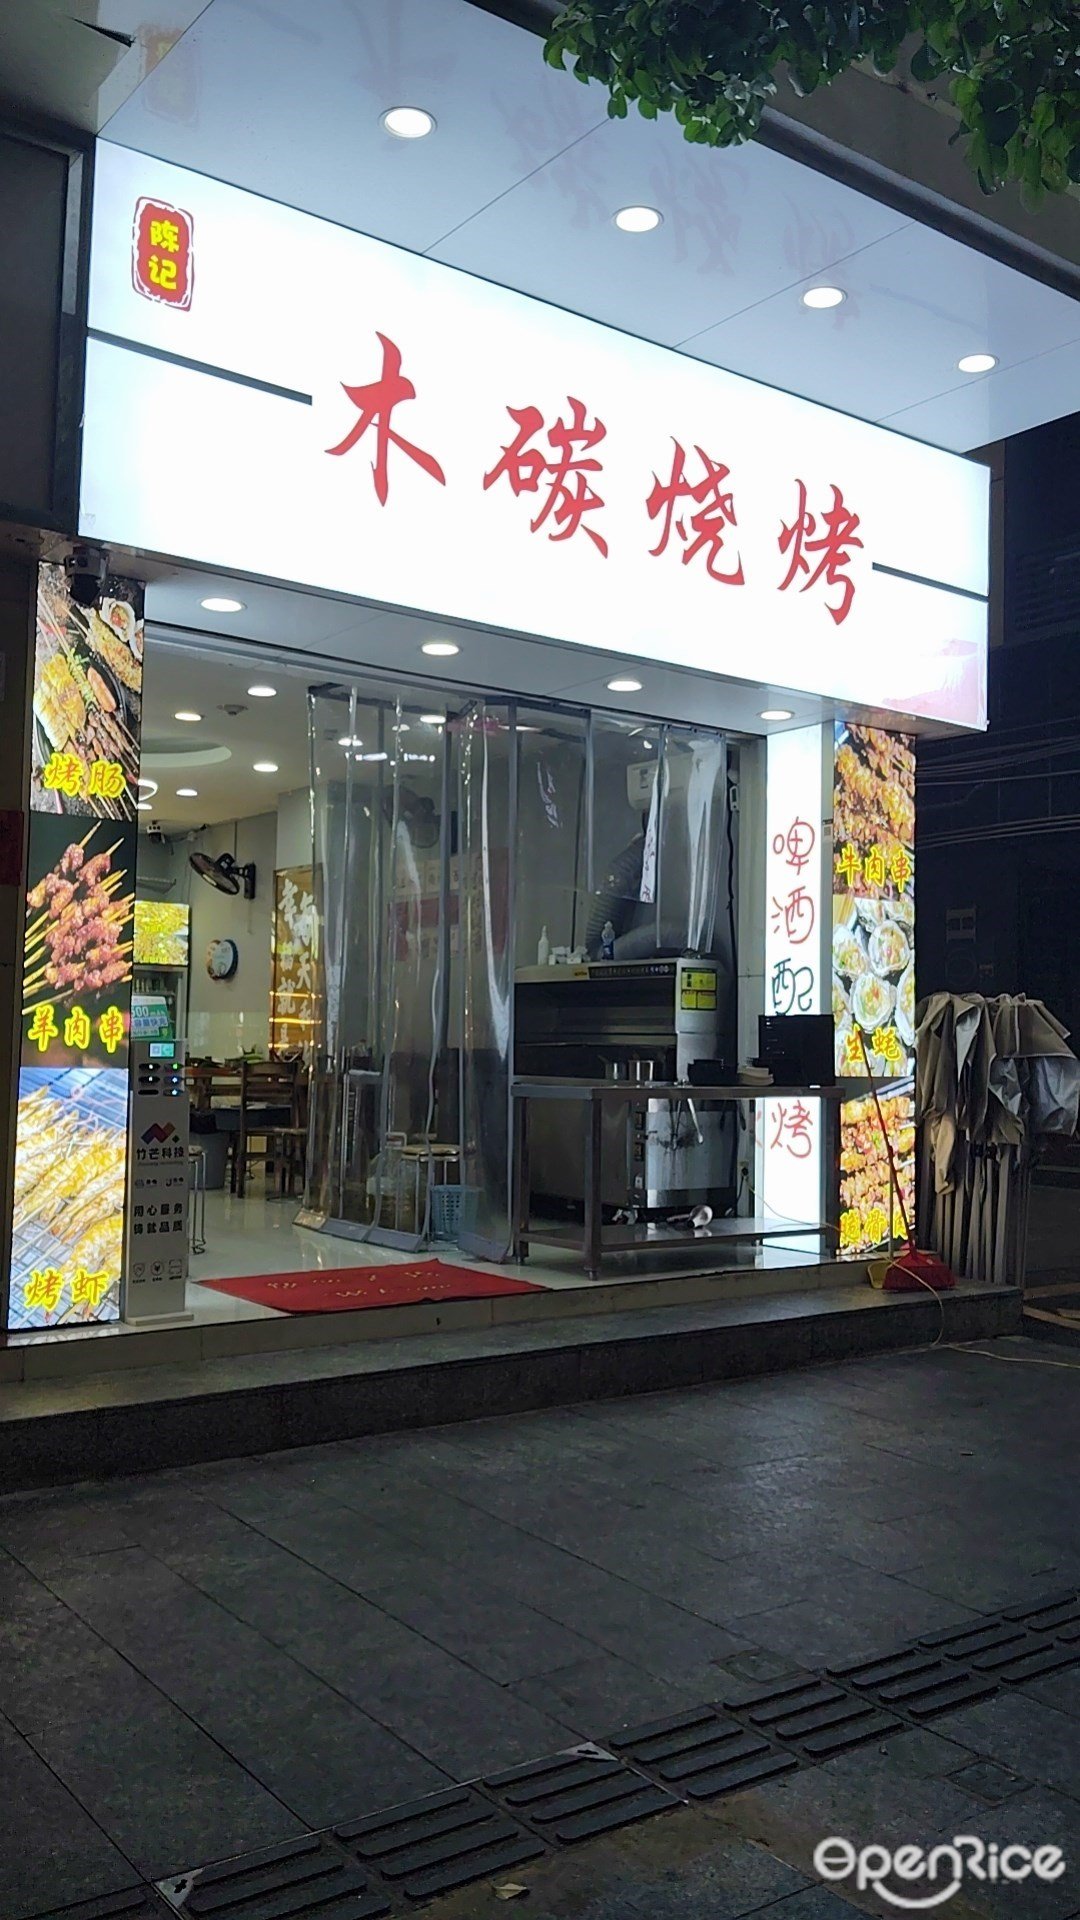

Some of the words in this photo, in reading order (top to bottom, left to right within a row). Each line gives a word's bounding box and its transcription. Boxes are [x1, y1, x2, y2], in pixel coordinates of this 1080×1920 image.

[148, 219, 180, 290] 陈记
[324, 330, 864, 626] 木碳烧烤
[43, 752, 127, 799] 烤肠
[837, 843, 911, 892] 牛肉串
[27, 1006, 128, 1053] 羊肉串
[846, 1023, 902, 1063] 生蚝
[24, 1268, 110, 1312] 烤虾
